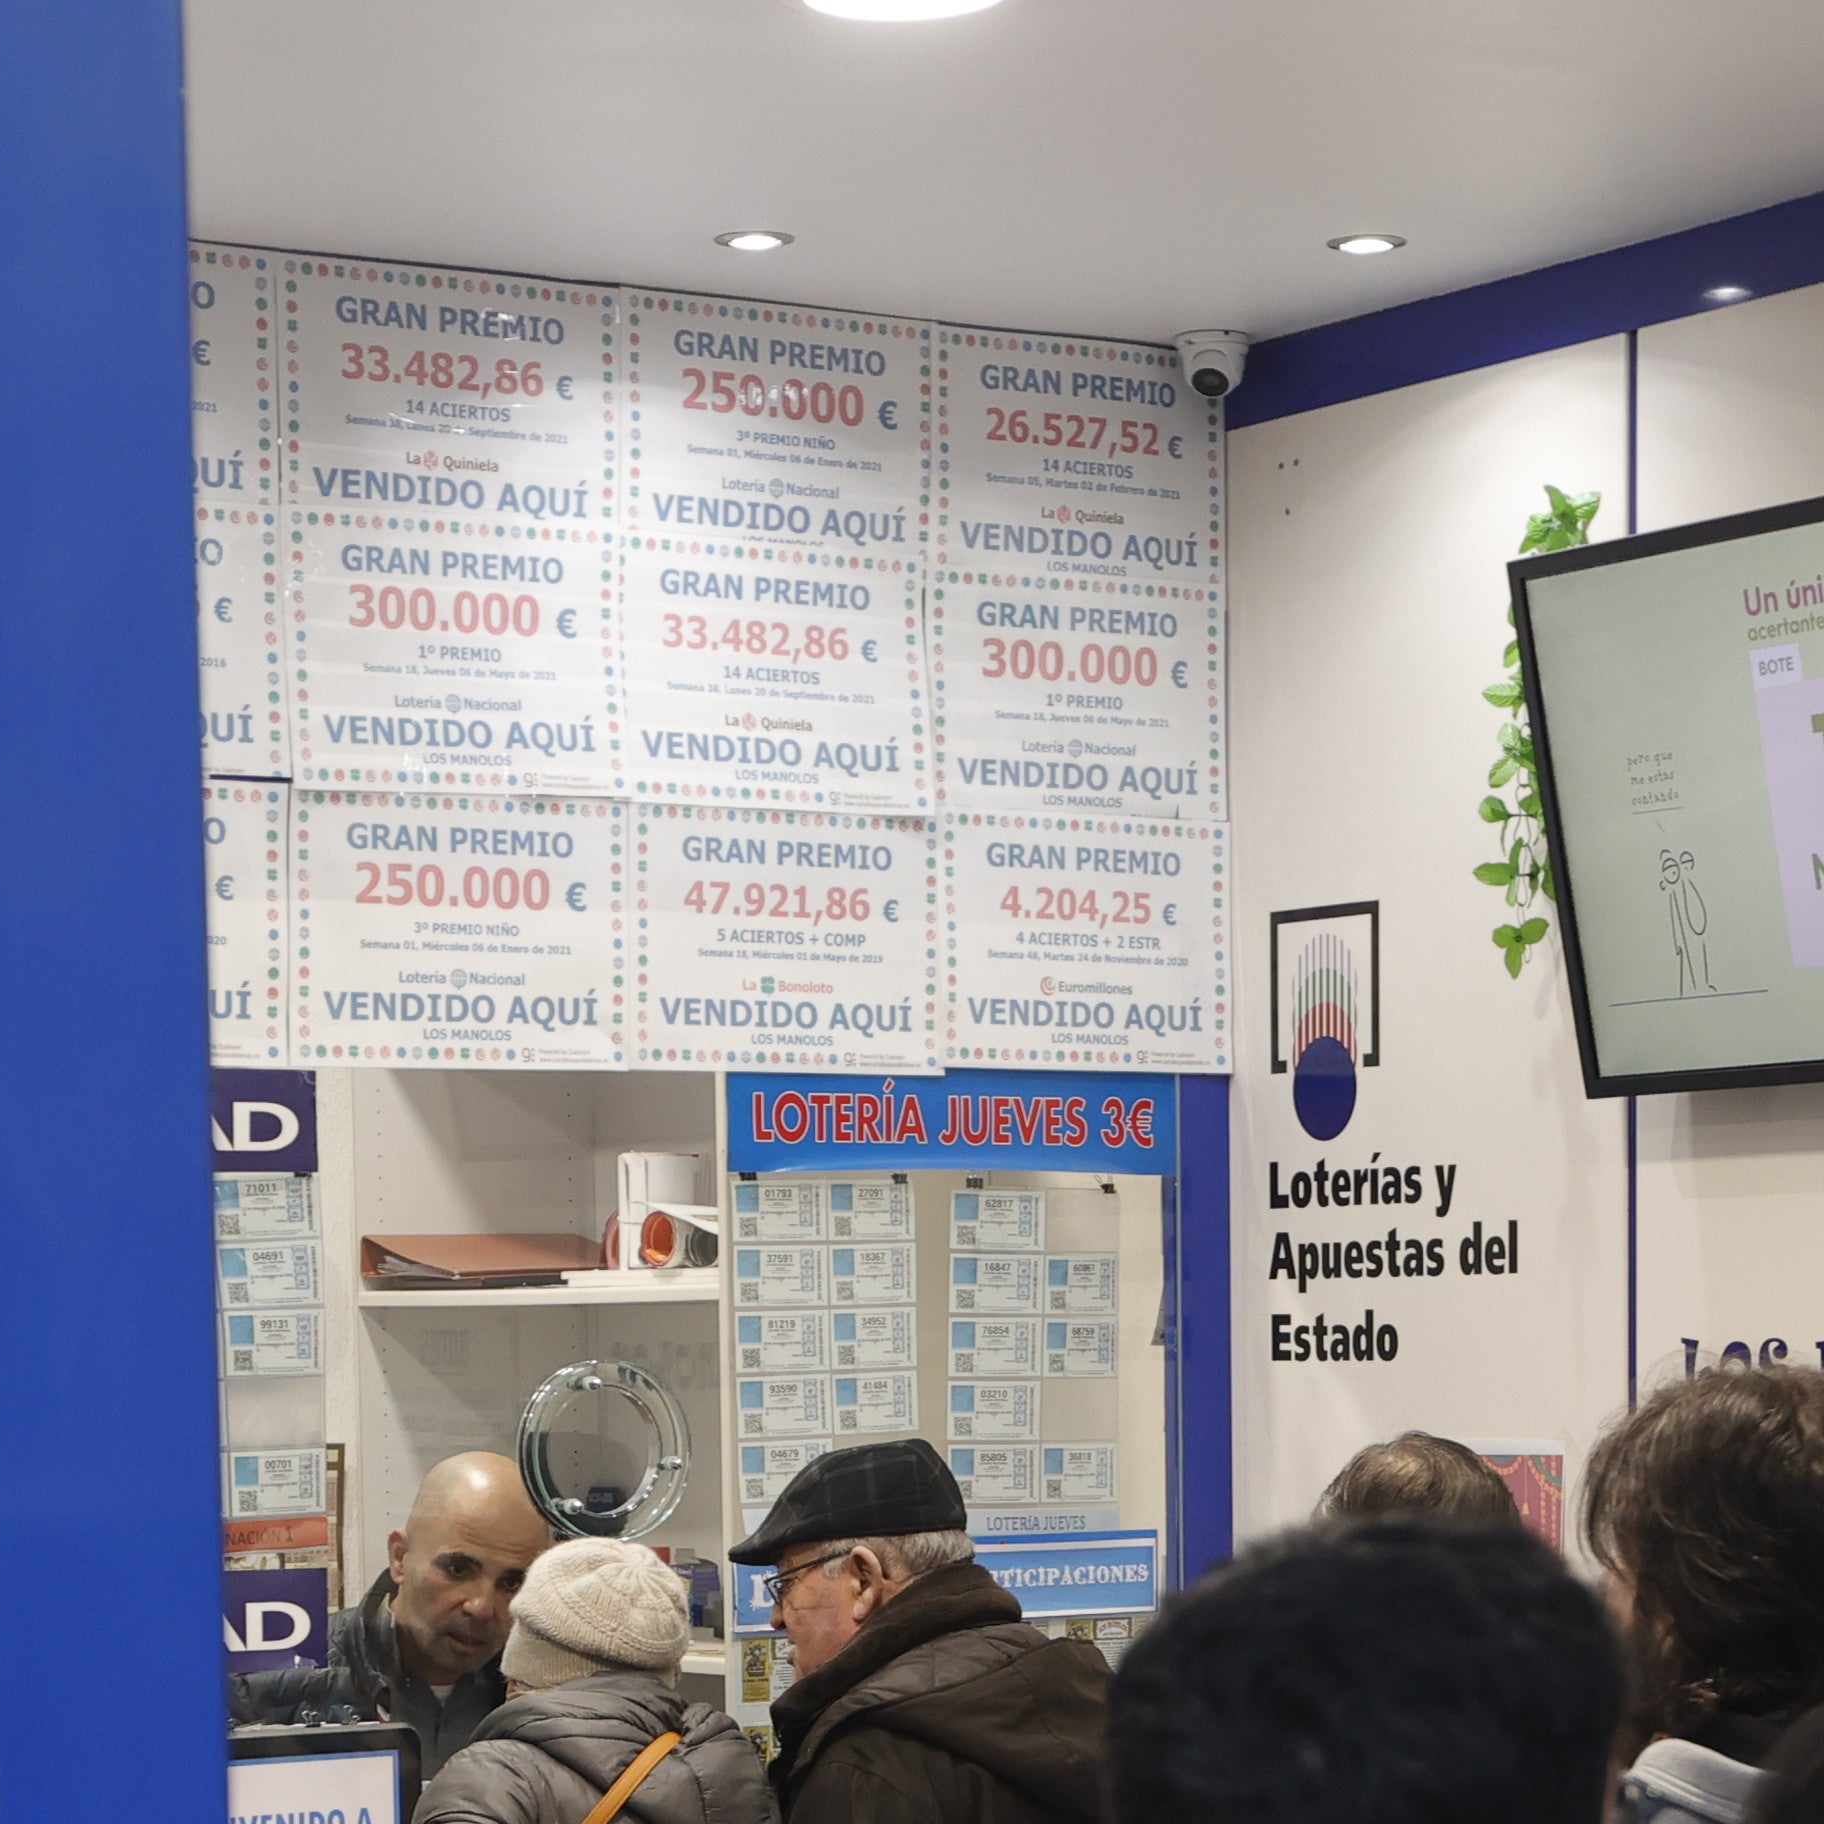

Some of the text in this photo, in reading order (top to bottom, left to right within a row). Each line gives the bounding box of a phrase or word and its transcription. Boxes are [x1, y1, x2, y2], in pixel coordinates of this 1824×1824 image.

[336, 296, 565, 345] GRAN PREMIO
[341, 343, 574, 401] 33.482,86 €
[682, 368, 898, 430] 250.000 €
[986, 407, 1183, 459] 26.527,52 €
[312, 467, 589, 520] VENDIDO AQUÍ
[348, 584, 578, 639] 300.000 €
[1742, 589, 1780, 617] Un
[662, 613, 879, 666] 33.482,86 €
[981, 638, 1188, 689] 300.000 €
[1757, 655, 1795, 676] BOTE
[324, 713, 596, 754] VENDIDO AQUÍ
[347, 823, 574, 858] GRAN PREMIO
[681, 836, 893, 872] GRAN PREMIO
[355, 862, 587, 912] 250.000 €
[684, 880, 900, 925] 47.921,86 €
[1000, 885, 1178, 931] 4.204,25 €
[432, 921, 520, 937] PREMIO NIÑO
[717, 928, 726, 944] 5
[730, 930, 805, 946] ACIERTOS
[824, 932, 866, 948] COMP
[742, 978, 834, 995] La Bonoloto
[1057, 981, 1133, 997] Euromillones
[423, 1028, 512, 1042] LOS MANOLOS
[968, 998, 1203, 1038] VENDIDO AQUÍ
[752, 1079, 1155, 1148] LOTERÍA JUEVES 3€
[245, 1183, 277, 1194] 71011
[1269, 1152, 1457, 1218] Loterías y
[766, 1254, 793, 1263] 37591
[984, 1263, 1010, 1272] 16847
[1269, 1220, 1518, 1294] Apuestas del
[260, 1320, 289, 1329] 99131
[1271, 1309, 1398, 1362] Estado
[986, 1515, 1086, 1532] LOTERÍA JUEVES
